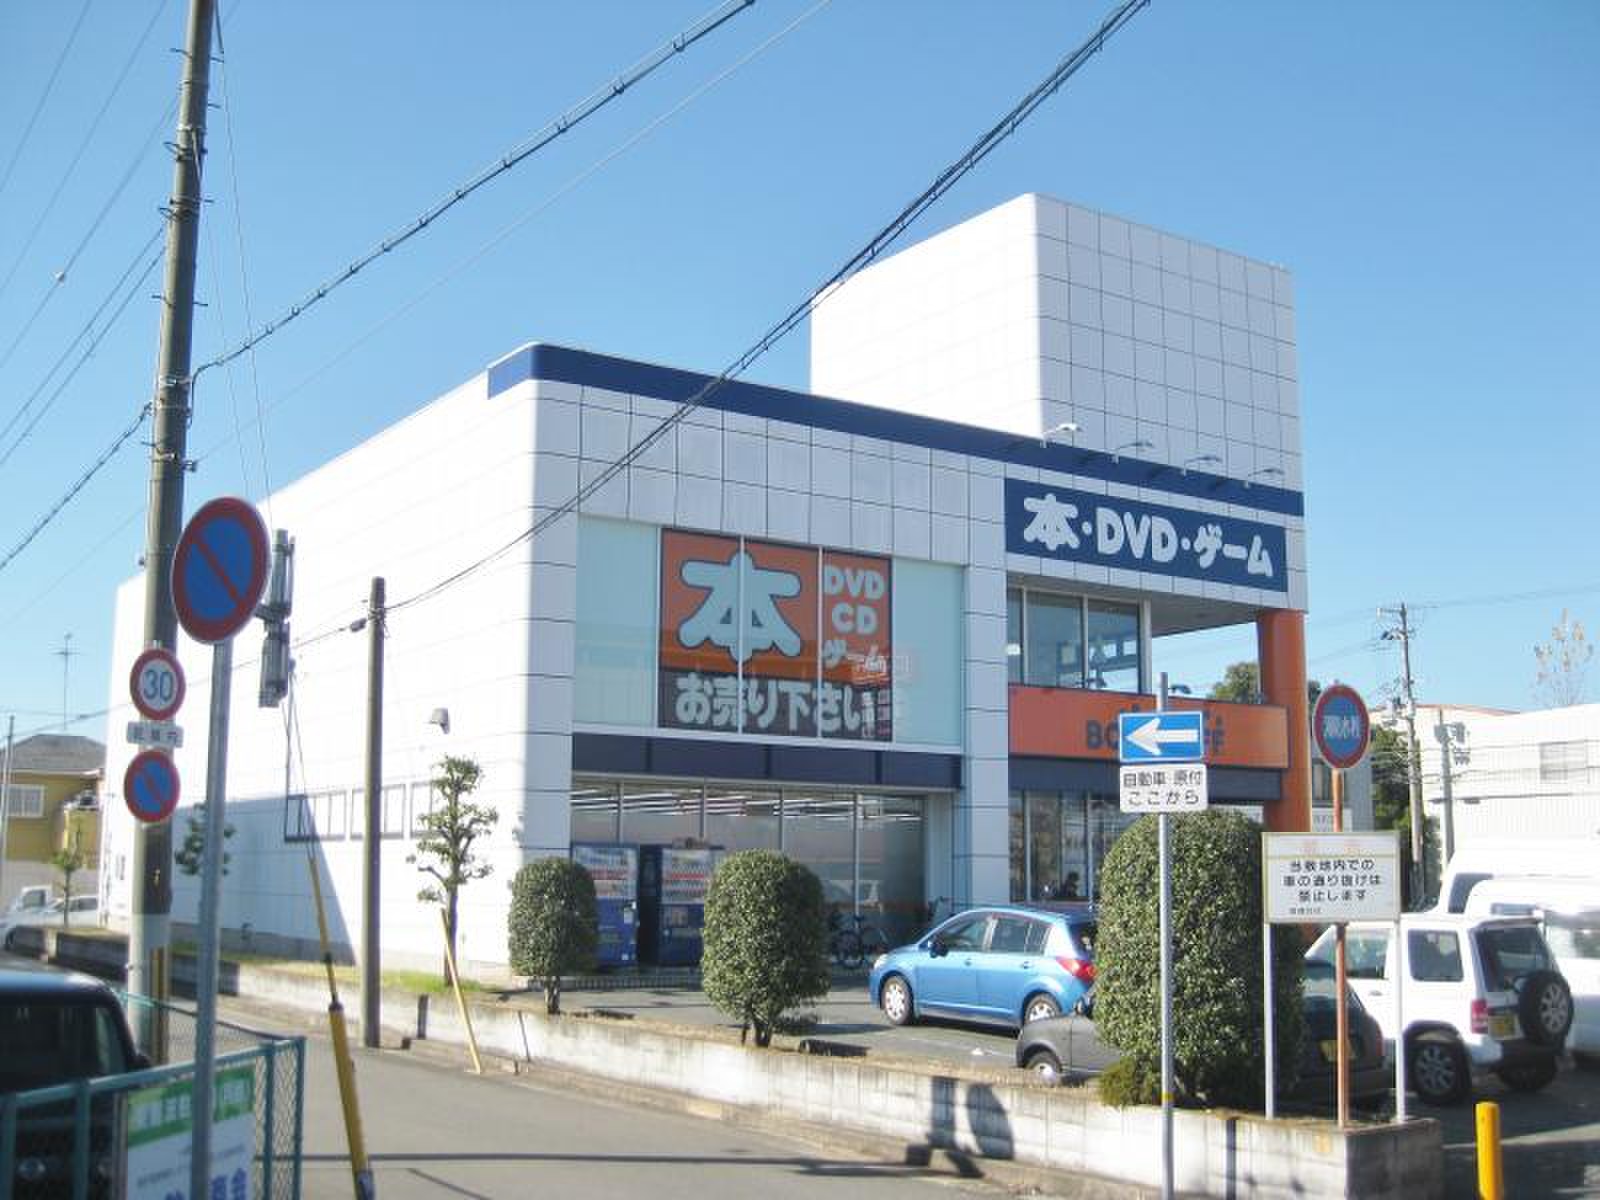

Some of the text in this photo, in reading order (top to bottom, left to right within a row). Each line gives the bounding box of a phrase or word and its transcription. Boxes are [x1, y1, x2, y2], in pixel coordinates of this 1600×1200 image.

[823, 564, 886, 600] DVD
[678, 549, 801, 664] 本
[831, 602, 878, 635] CD
[143, 669, 174, 702] 30
[674, 671, 876, 733] お売り下さい
[1128, 789, 1200, 806] ここから
[1298, 889, 1366, 903] 禁止します
